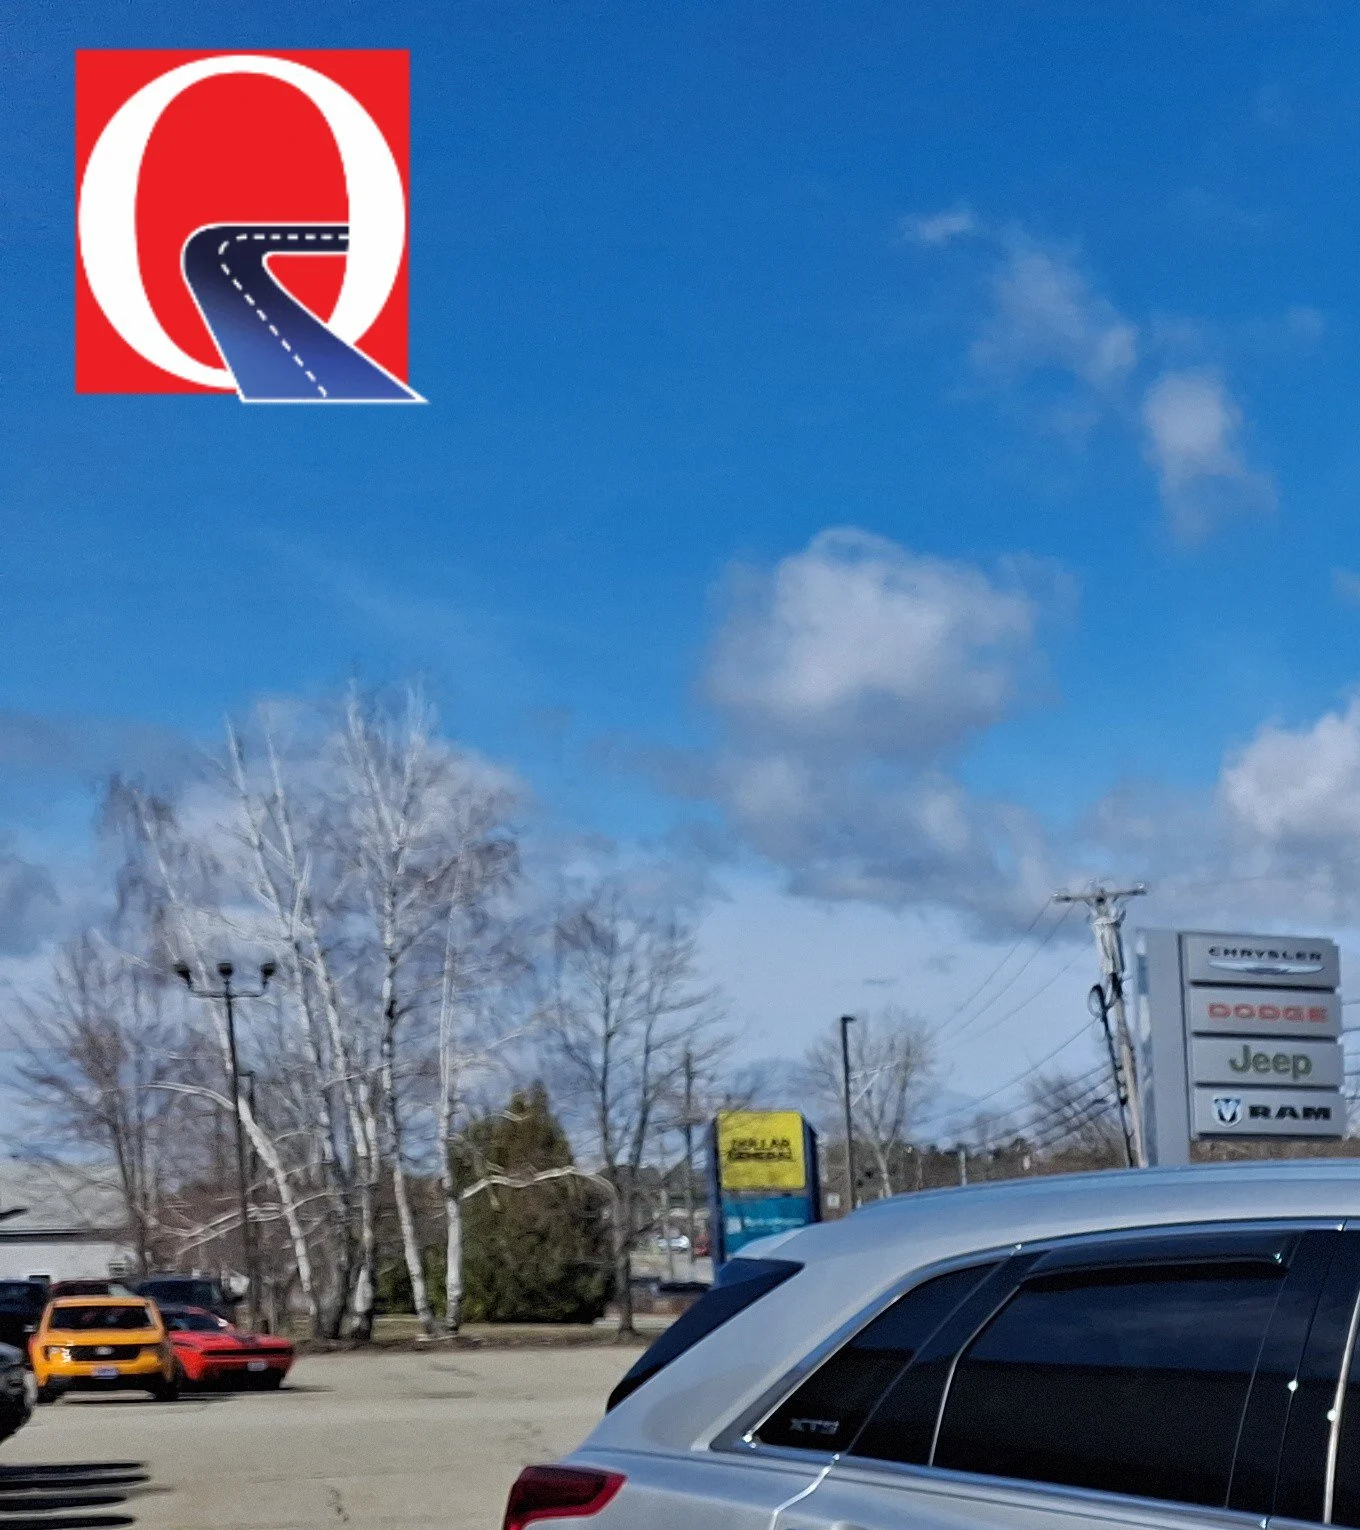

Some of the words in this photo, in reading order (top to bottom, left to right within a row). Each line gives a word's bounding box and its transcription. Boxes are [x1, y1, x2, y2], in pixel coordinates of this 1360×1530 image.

[1208, 946, 1323, 961] CHRYSLER
[1207, 1002, 1329, 1023] DODGE
[1229, 1044, 1313, 1079] Jeep
[1248, 1104, 1333, 1121] RAM
